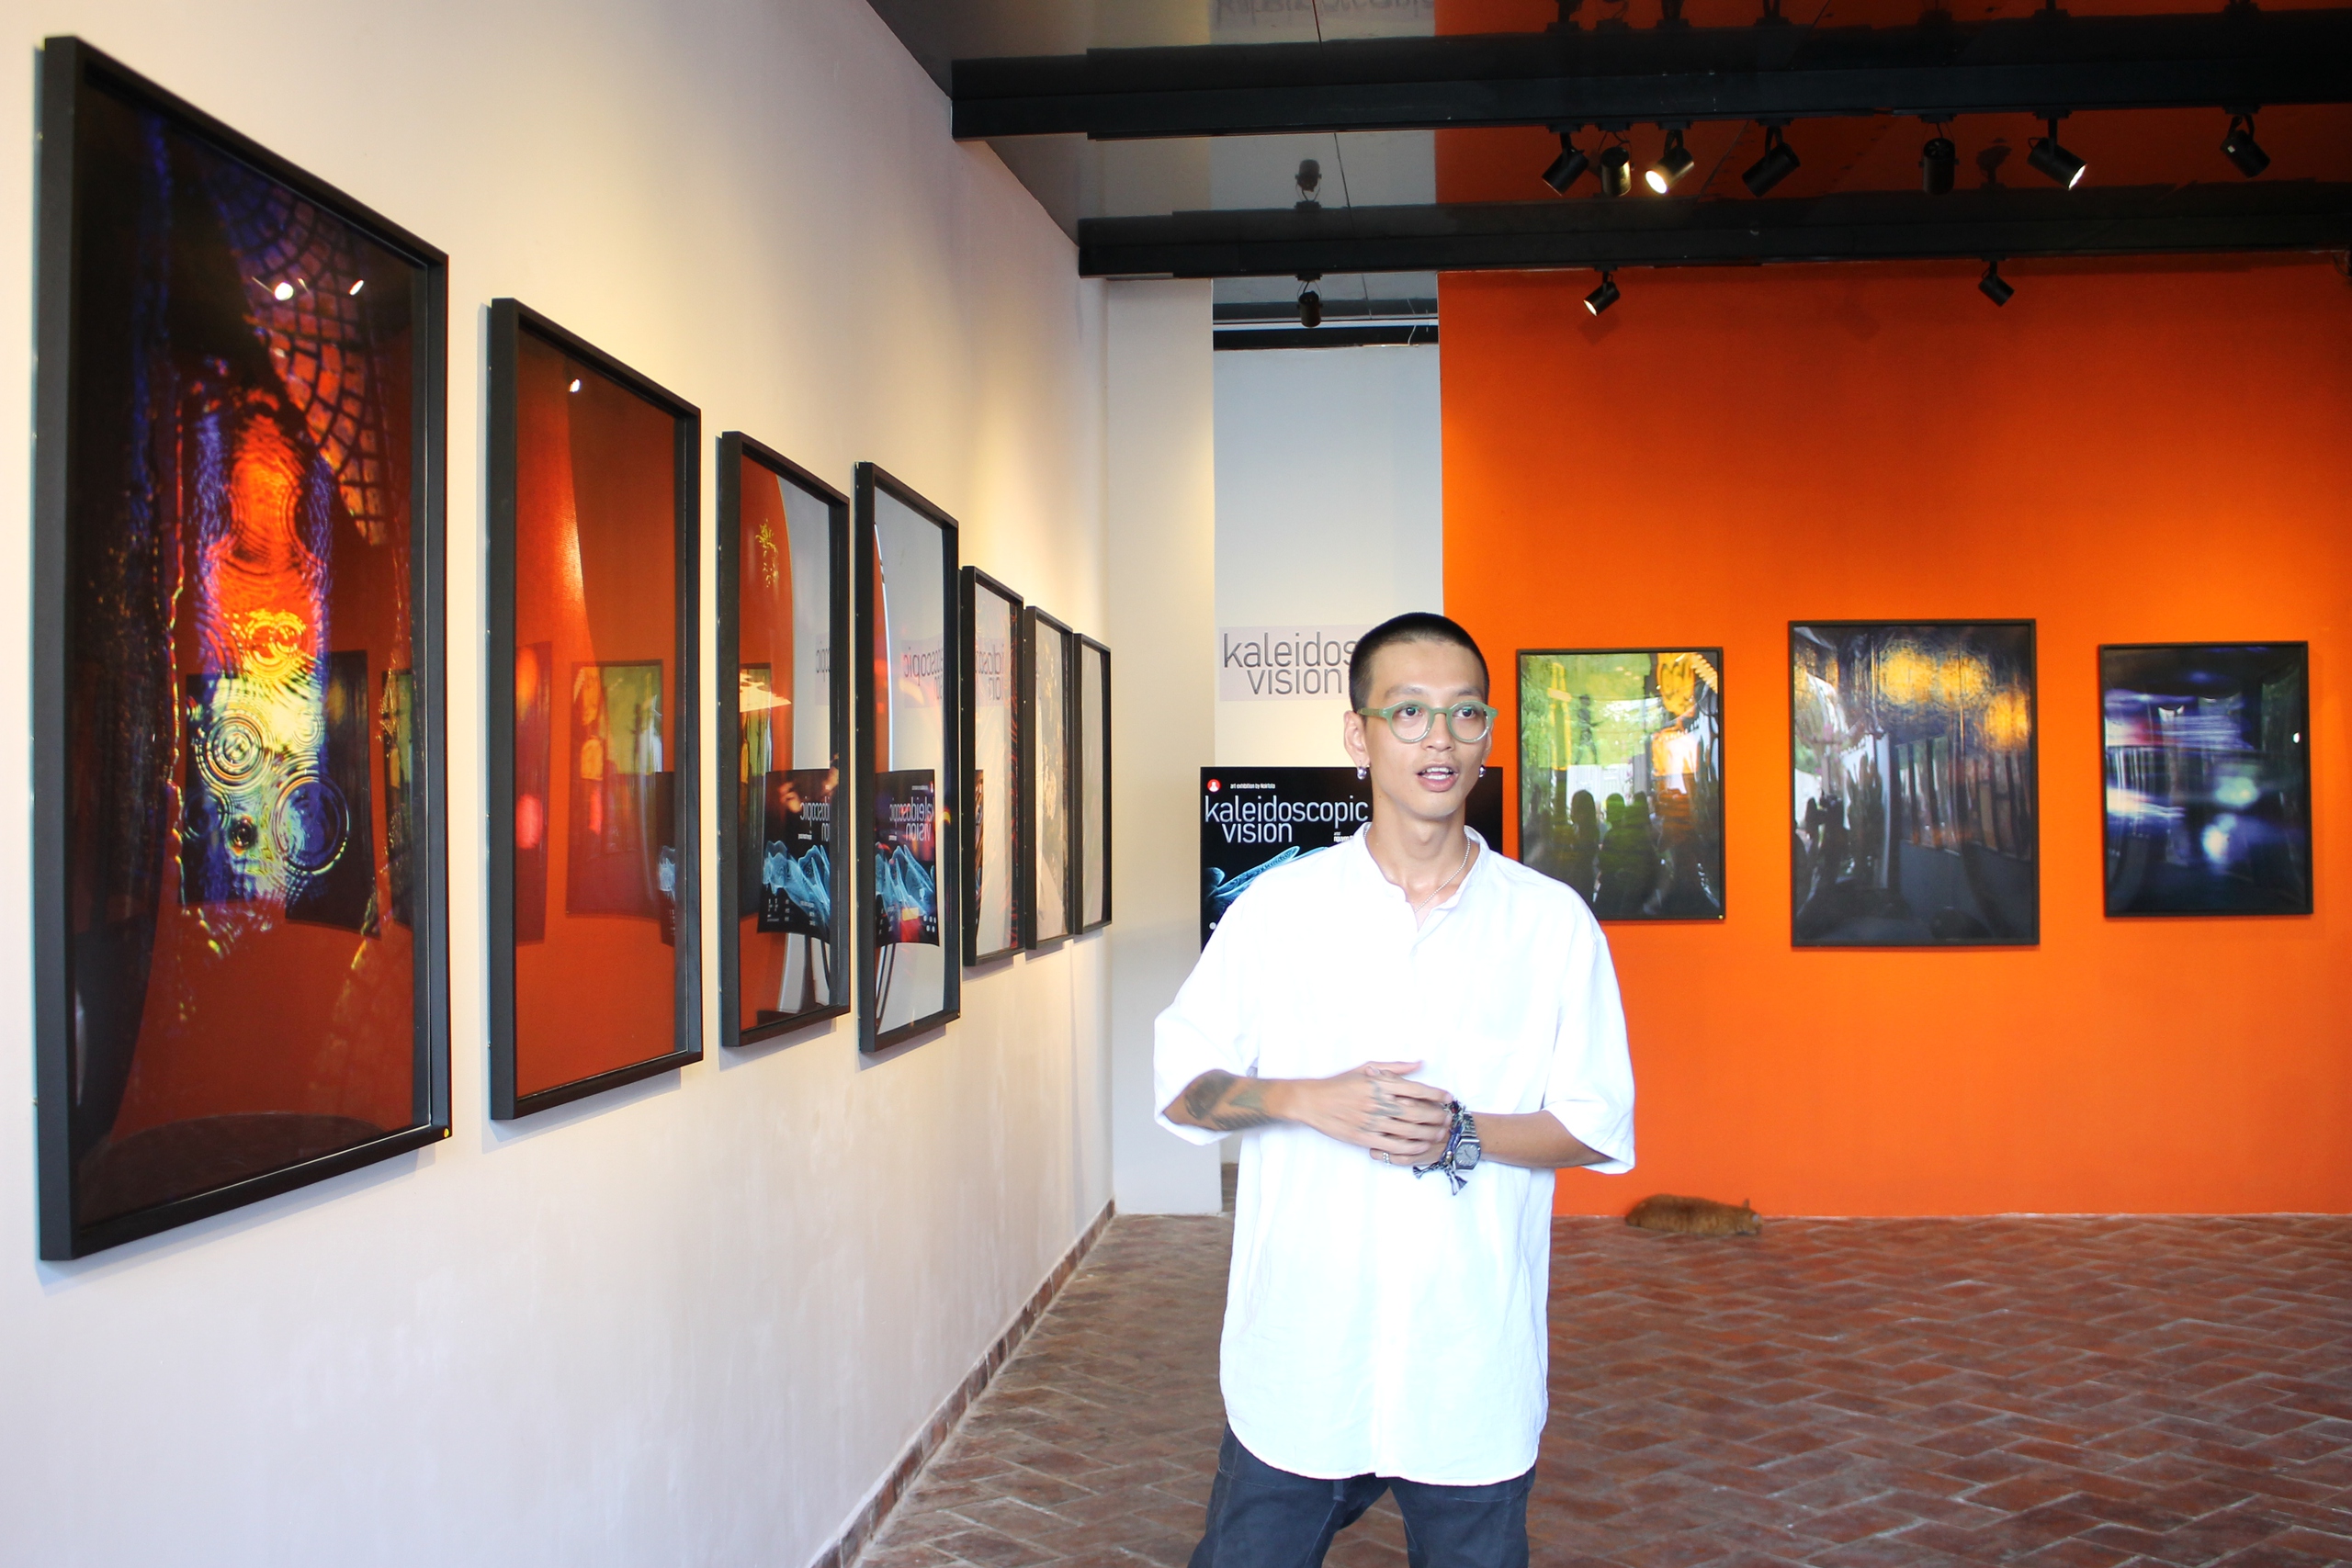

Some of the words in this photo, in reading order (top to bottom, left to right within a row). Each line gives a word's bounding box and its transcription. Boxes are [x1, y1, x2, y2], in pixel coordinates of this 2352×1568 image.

[1247, 668, 1342, 694] vision
[1204, 795, 1369, 829] kaleidoscopic
[1222, 823, 1293, 842] vision
